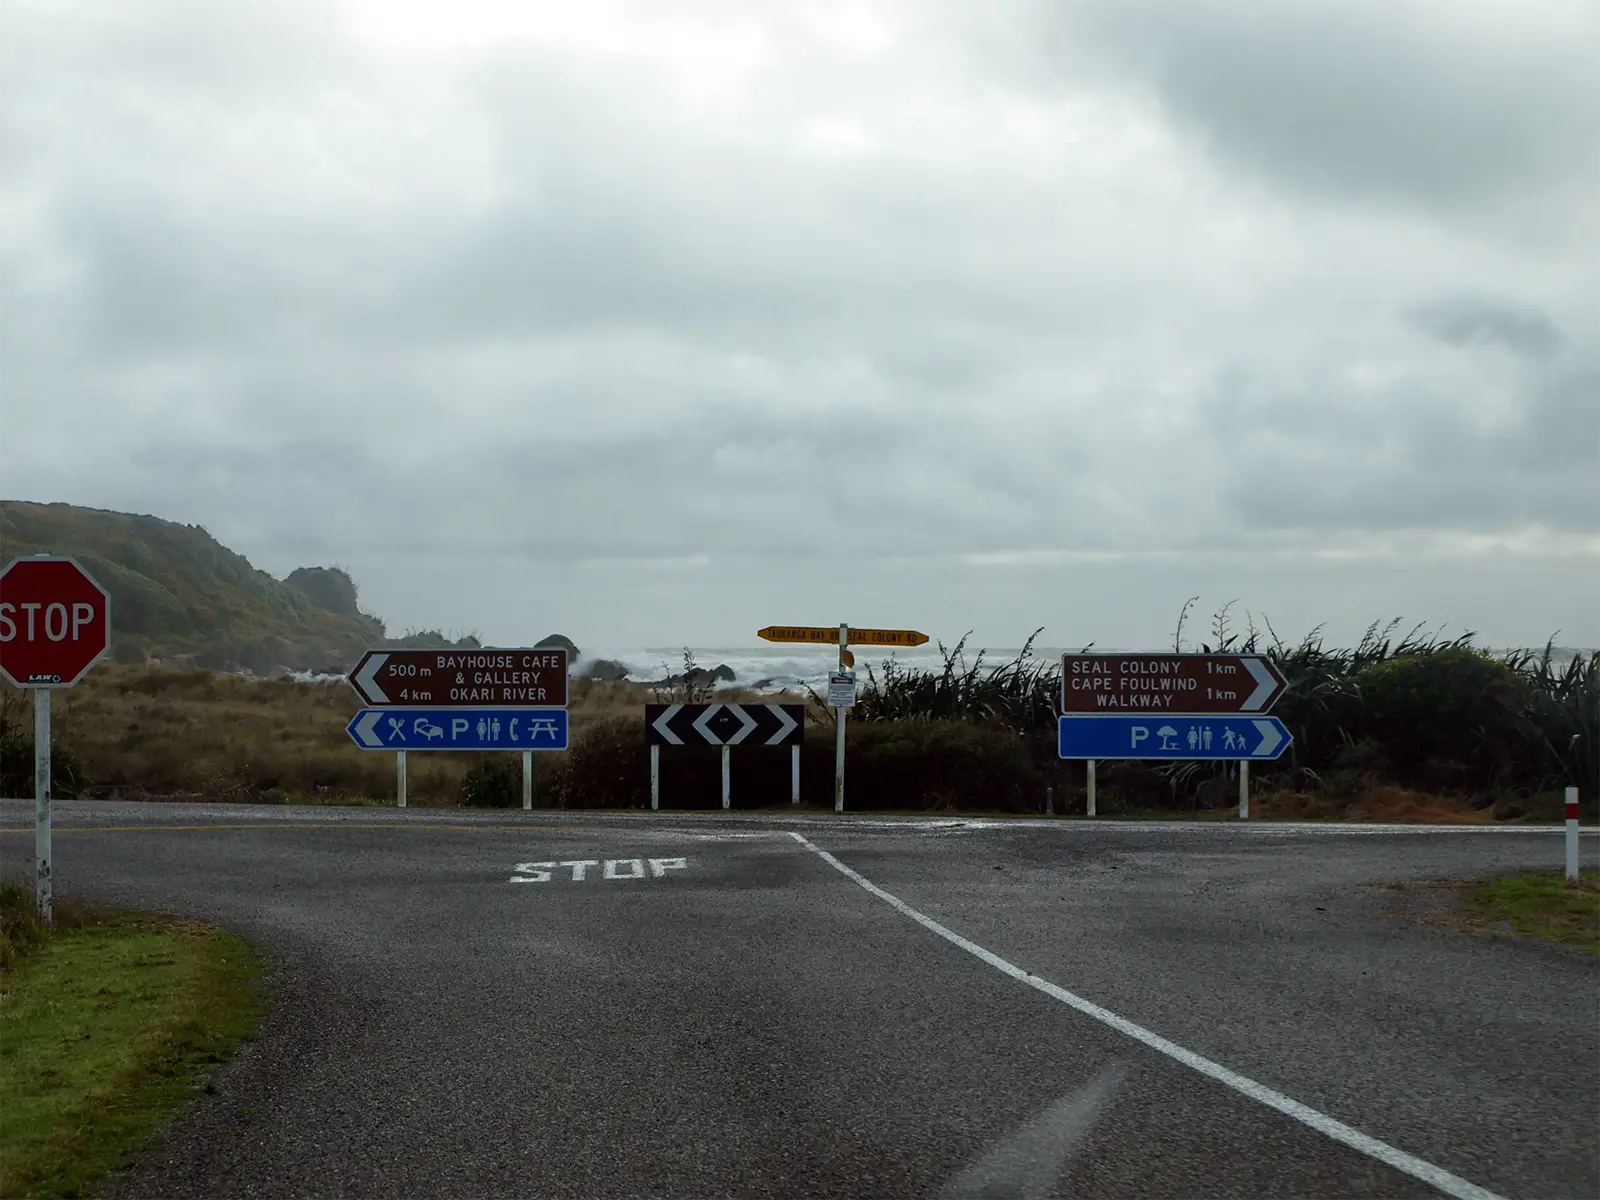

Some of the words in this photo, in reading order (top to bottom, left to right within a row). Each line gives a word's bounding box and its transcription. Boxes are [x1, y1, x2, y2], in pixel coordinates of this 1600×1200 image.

[0, 602, 95, 642] STOP
[811, 631, 825, 640] BAY
[848, 631, 868, 641] SEAL
[872, 632, 902, 643] COLONY
[906, 633, 917, 643] RD
[437, 656, 513, 668] BAYHOUSE
[522, 656, 559, 668] CAFE
[1071, 661, 1111, 674] SEAL
[1120, 661, 1181, 674] COLONY
[1207, 661, 1213, 674] 1
[1216, 662, 1236, 674] km
[389, 665, 418, 677] 500
[420, 667, 432, 677] m
[455, 672, 465, 684] &
[474, 672, 541, 684] GALLERY
[1071, 678, 1112, 690] CAPE
[1120, 678, 1197, 690] FOULWIND
[400, 689, 409, 700] 4
[413, 689, 432, 700] km
[450, 688, 495, 700] OKARI
[503, 688, 547, 700] RIVER
[1207, 687, 1213, 700] 1
[1216, 688, 1236, 700] km
[1096, 694, 1173, 707] WALKWAY
[451, 718, 470, 740] P
[1131, 726, 1150, 749] P
[508, 857, 688, 883] STOP
